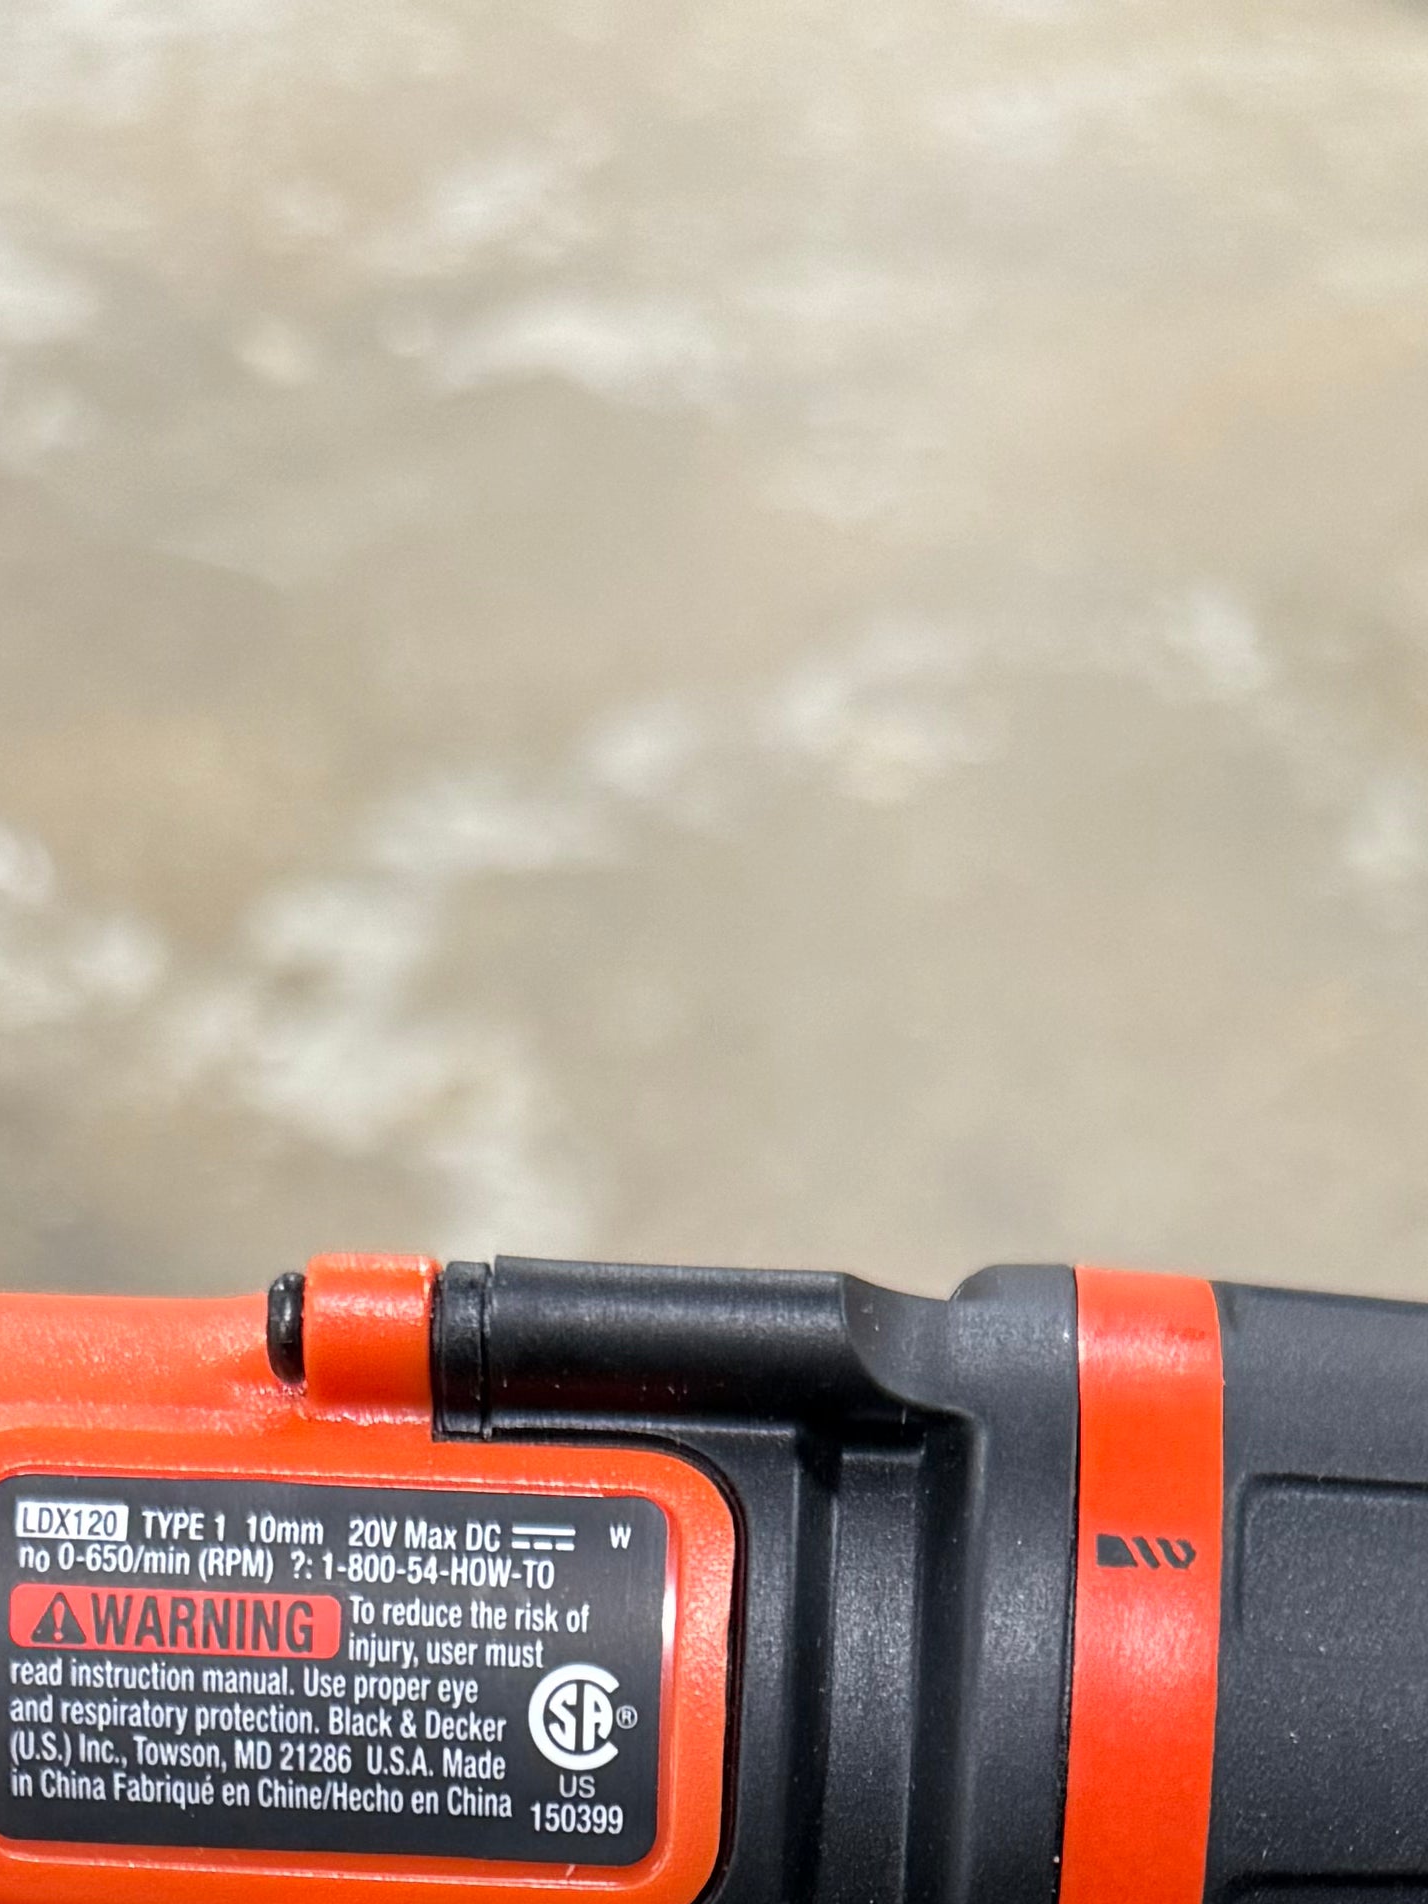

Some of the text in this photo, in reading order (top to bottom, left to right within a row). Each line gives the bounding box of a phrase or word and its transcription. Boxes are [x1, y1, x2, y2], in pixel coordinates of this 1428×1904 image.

[22, 1506, 501, 1552] LDX120 TYPE 1 10mm 20V Max DC
[609, 1525, 631, 1549] W
[58, 1543, 190, 1575] 0-650/min
[199, 1549, 273, 1584] (RPM)
[322, 1551, 555, 1589] 1-800-54-HOW-TO
[91, 1592, 313, 1653] WARNING
[350, 1595, 590, 1633] To reduce the risk of
[348, 1632, 544, 1669] injury, user must
[10, 1657, 478, 1709] read instruction manual. Use proper eye
[9, 1695, 506, 1742] and respiratory protection. Black & Decker
[10, 1731, 506, 1780] (U.S.) Inc., Towson, MD 21286 U.S.A. Made
[12, 1769, 513, 1818] in China Fabriqué en Chine/Hecho en China
[559, 1774, 596, 1799] US
[530, 1801, 624, 1835] 150399
